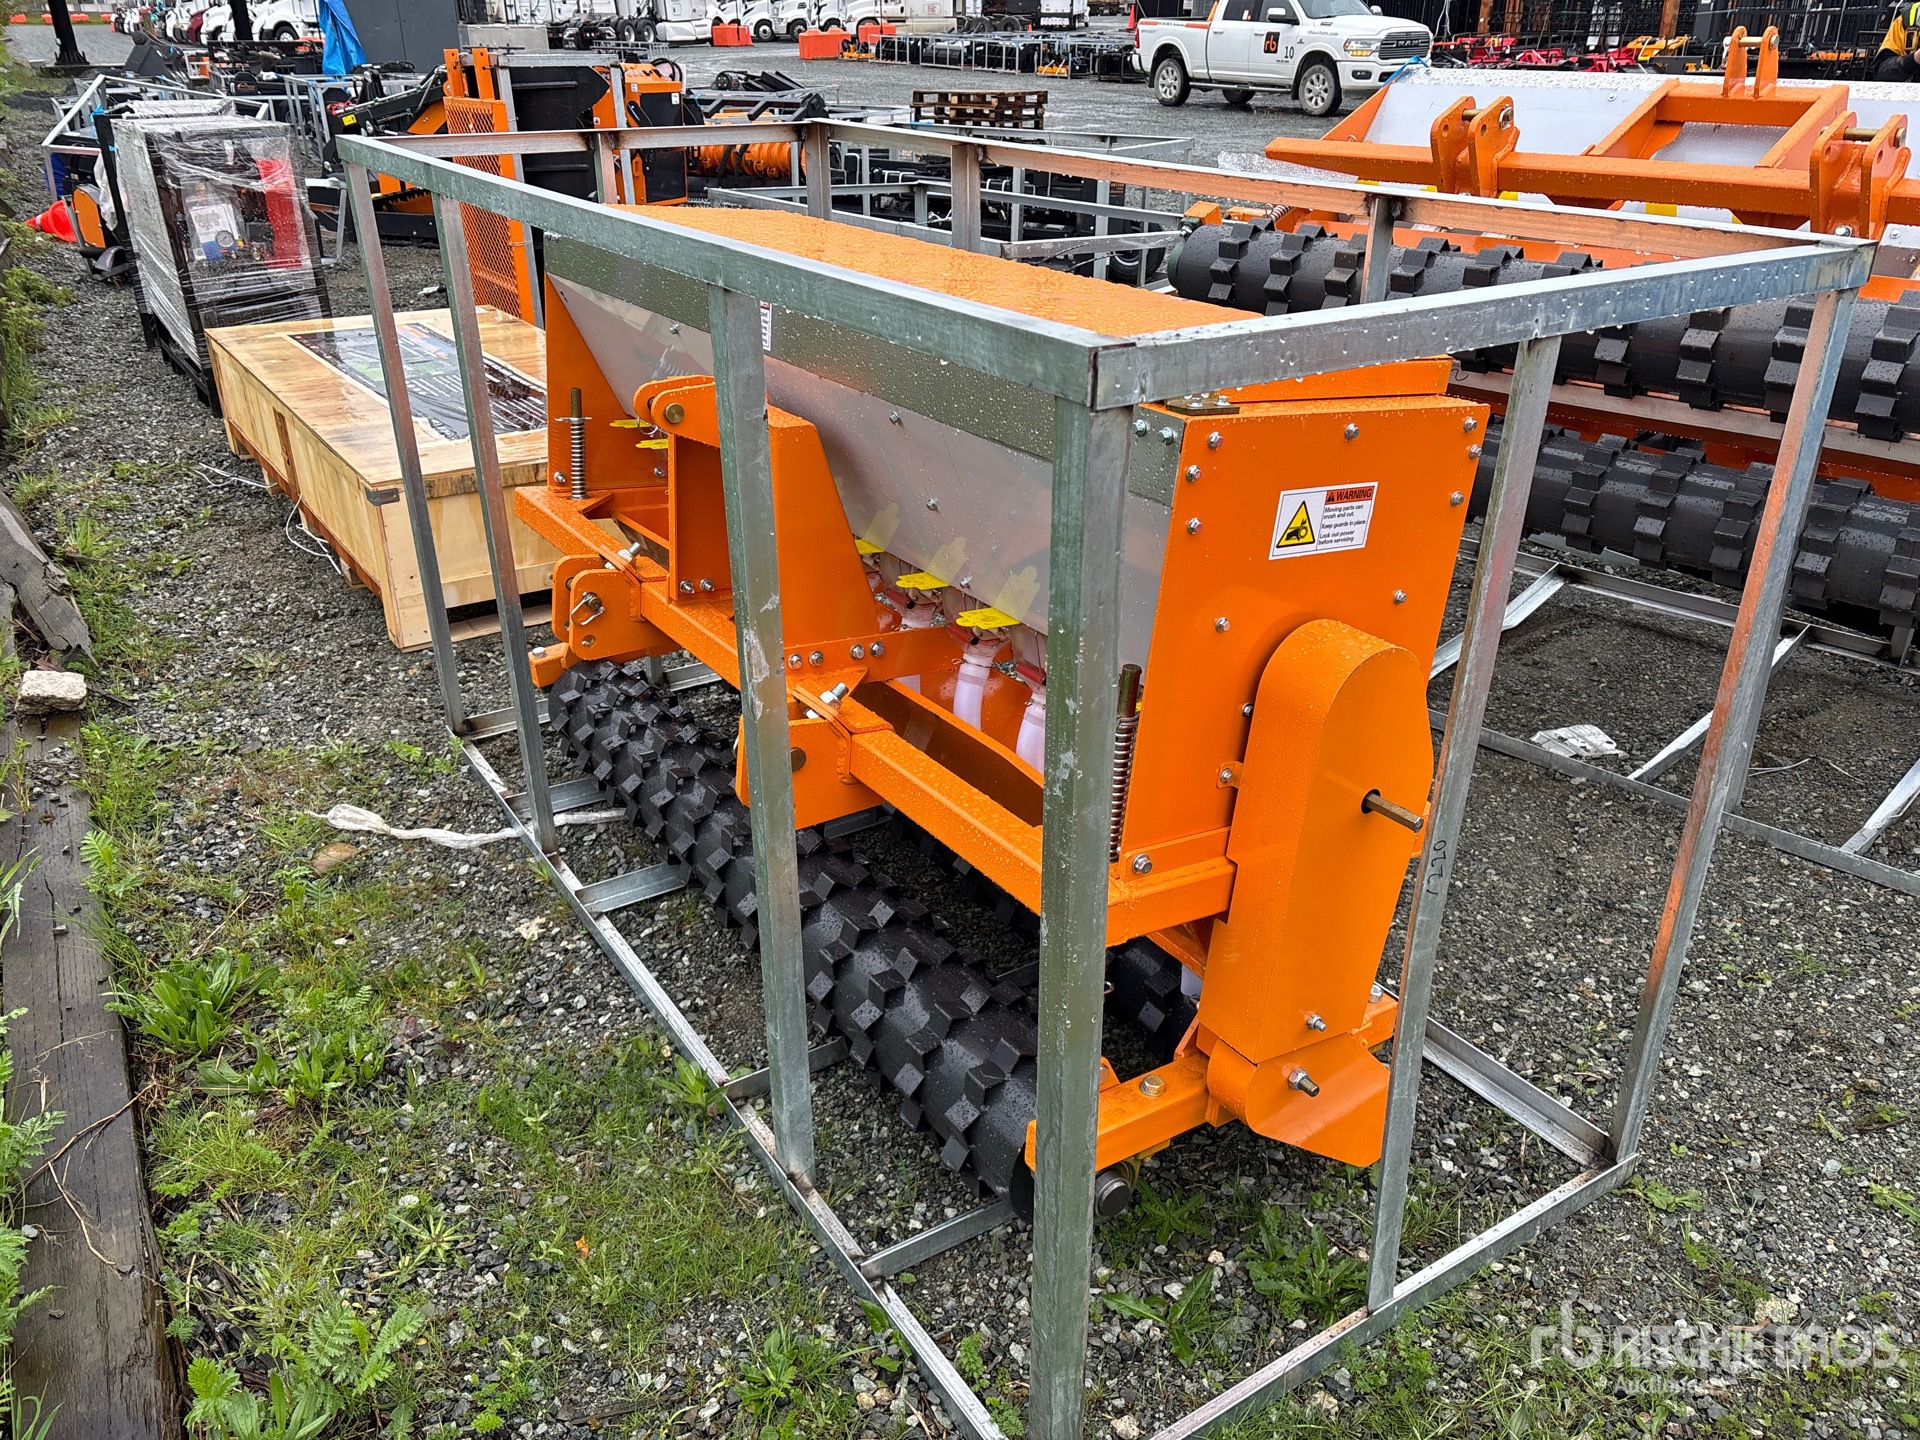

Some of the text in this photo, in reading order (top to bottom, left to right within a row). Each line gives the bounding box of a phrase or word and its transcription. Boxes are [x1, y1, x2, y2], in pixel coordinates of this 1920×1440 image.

[1265, 35, 1277, 52] rb
[1284, 45, 1295, 59] 10
[1336, 488, 1372, 500] WARNING
[1333, 521, 1349, 529] guards
